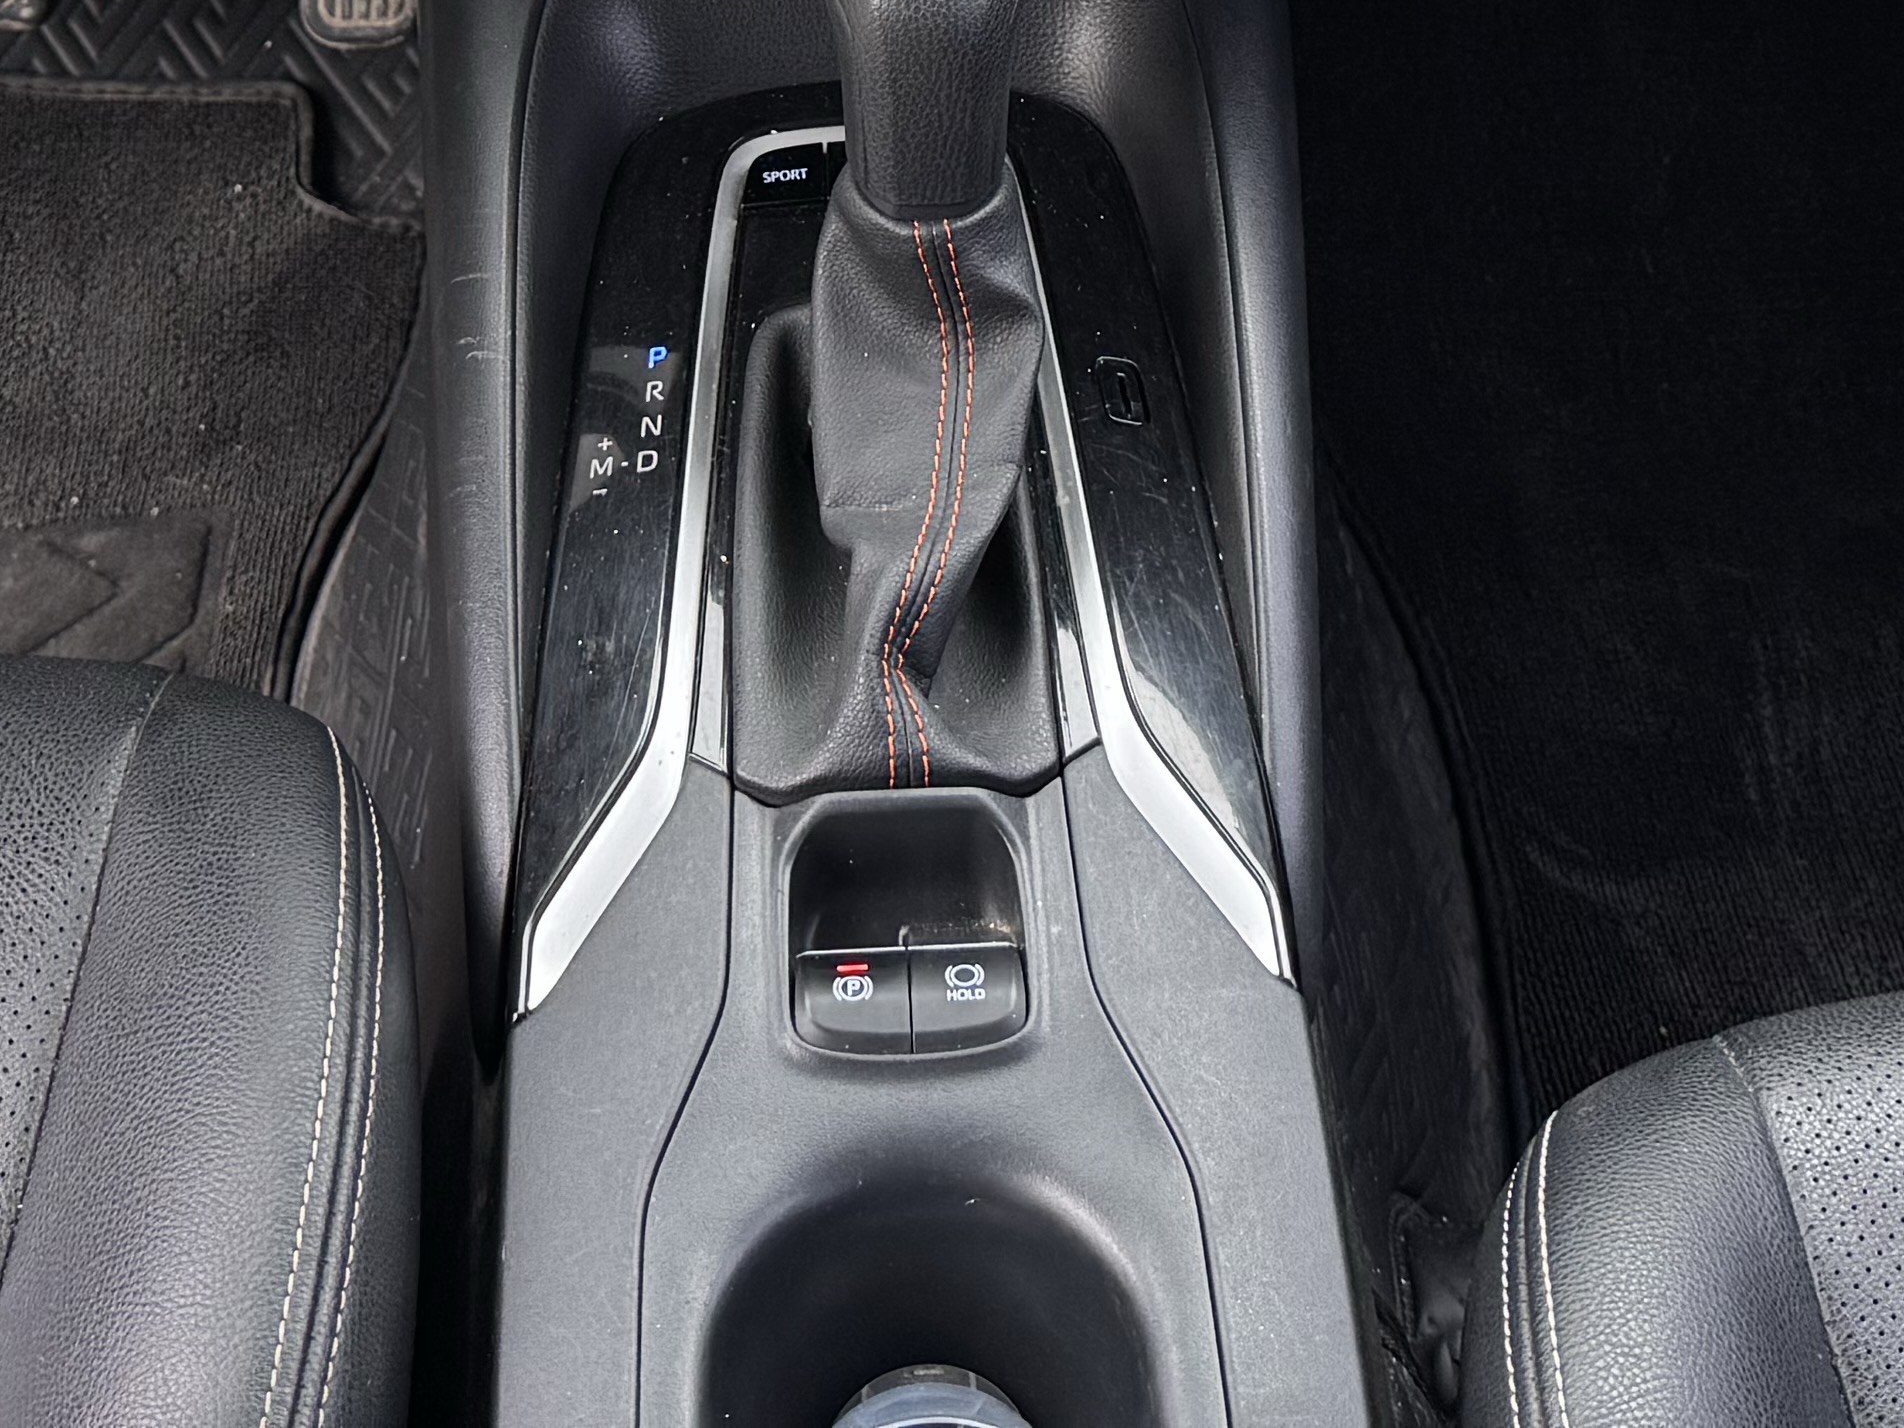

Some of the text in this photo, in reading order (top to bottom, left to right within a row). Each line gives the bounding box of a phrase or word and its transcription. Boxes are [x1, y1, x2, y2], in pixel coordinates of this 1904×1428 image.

[762, 167, 809, 184] SPORT
[648, 346, 668, 369] P
[645, 380, 665, 403] R
[640, 414, 663, 438] N
[589, 449, 659, 480] M D
[946, 988, 986, 1002] HOLD
